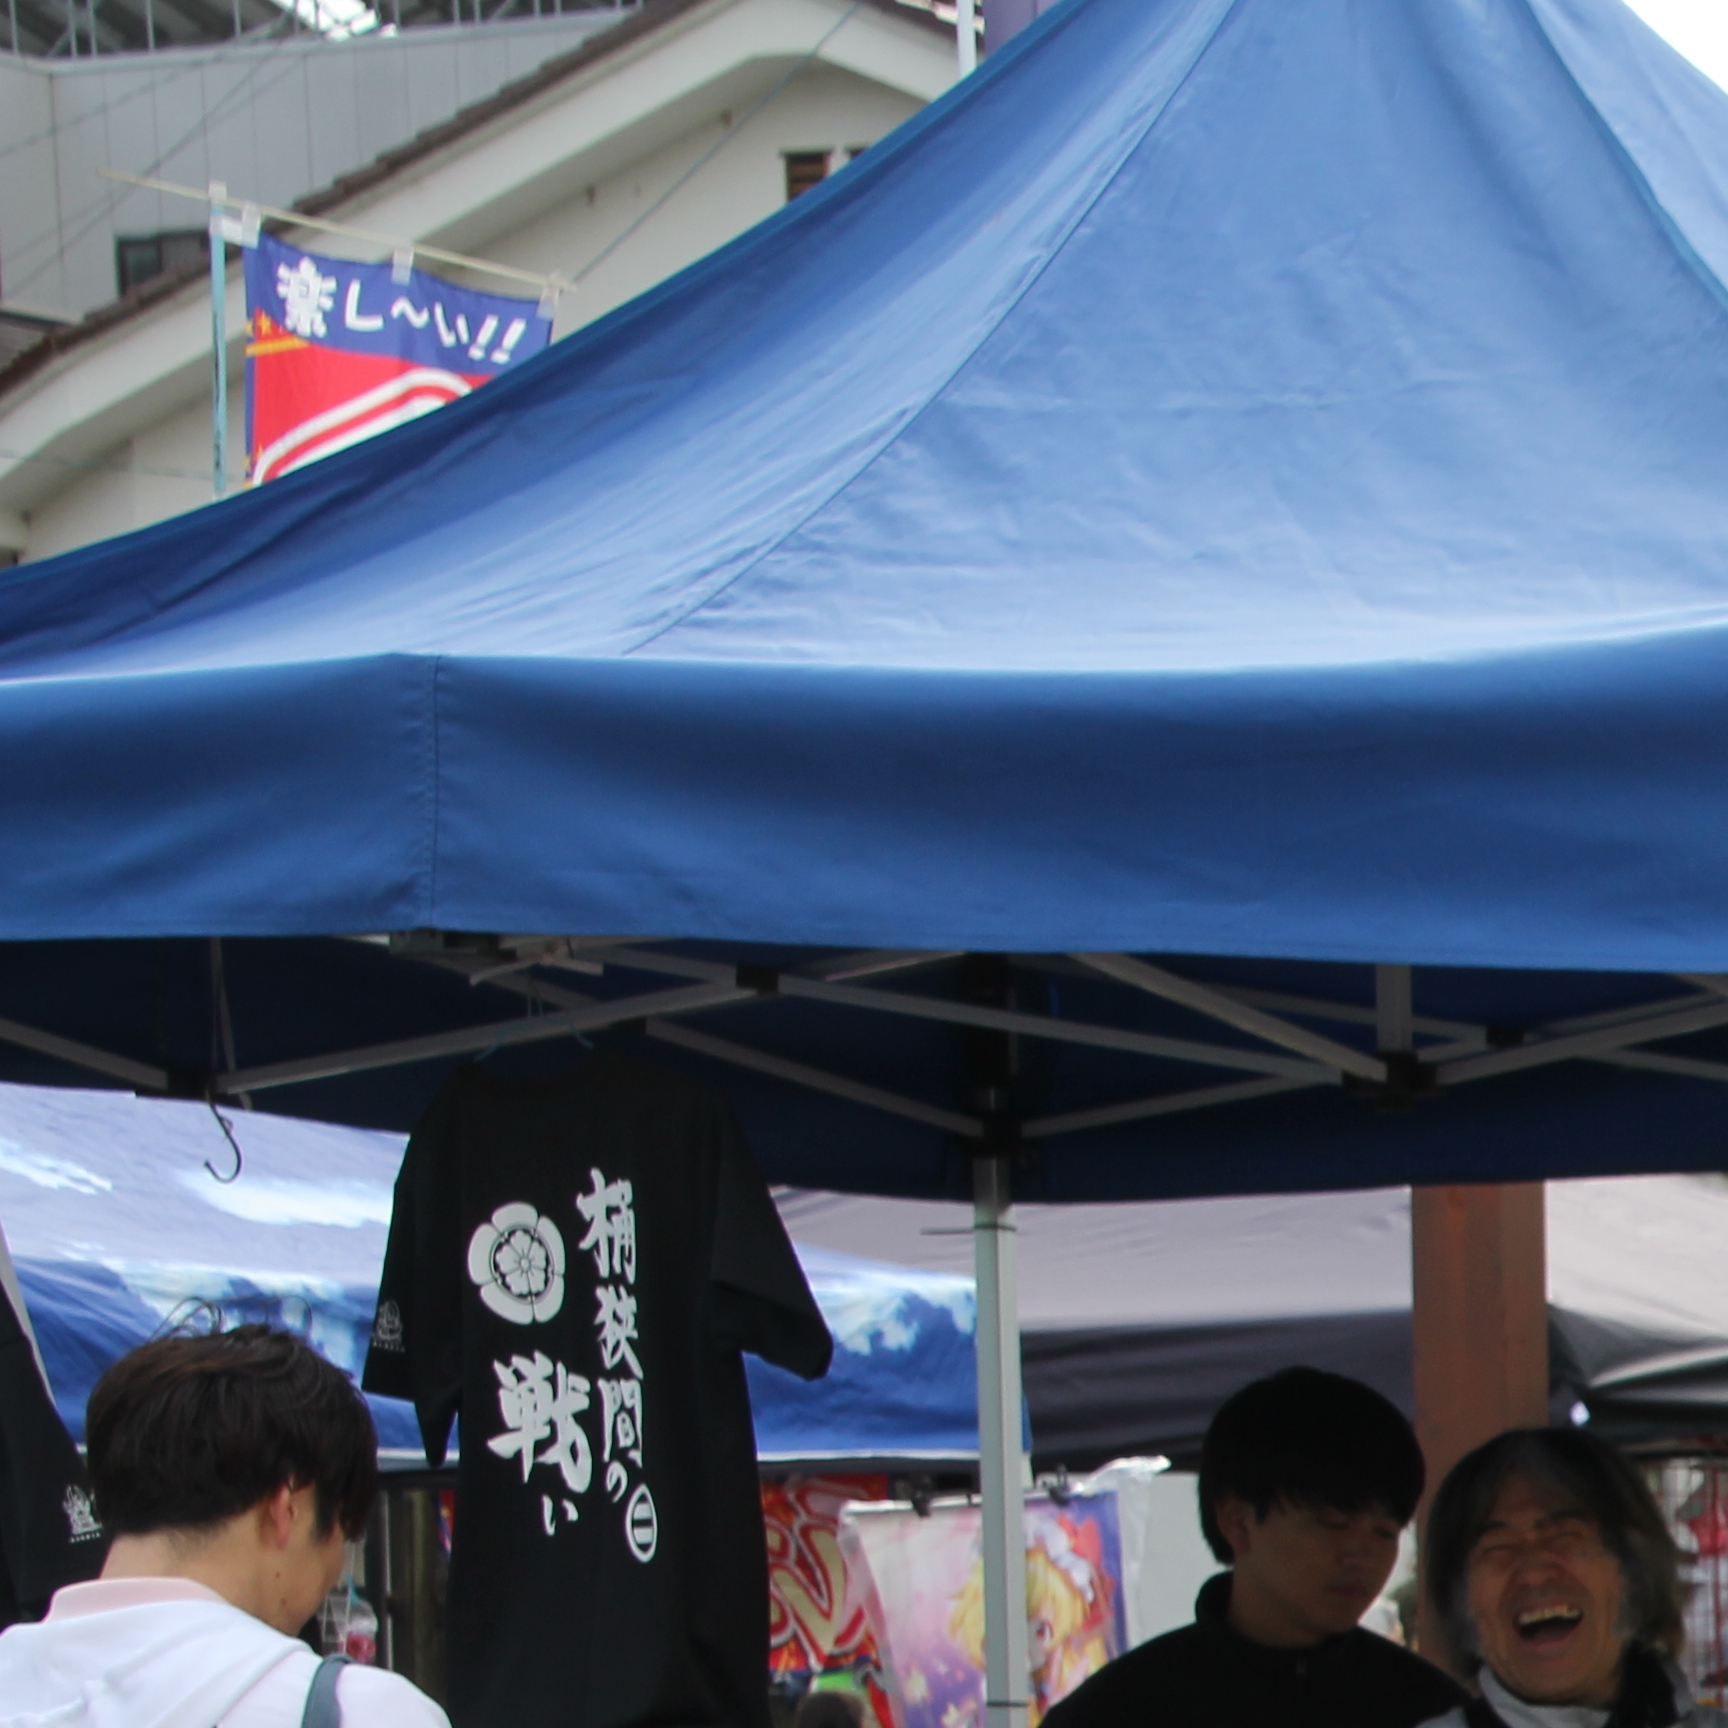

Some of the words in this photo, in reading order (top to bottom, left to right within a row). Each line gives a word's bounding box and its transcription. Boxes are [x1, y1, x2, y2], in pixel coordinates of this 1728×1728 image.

[487, 1350, 593, 1536] 戦い
[576, 1167, 644, 1504] 桶狭間の
